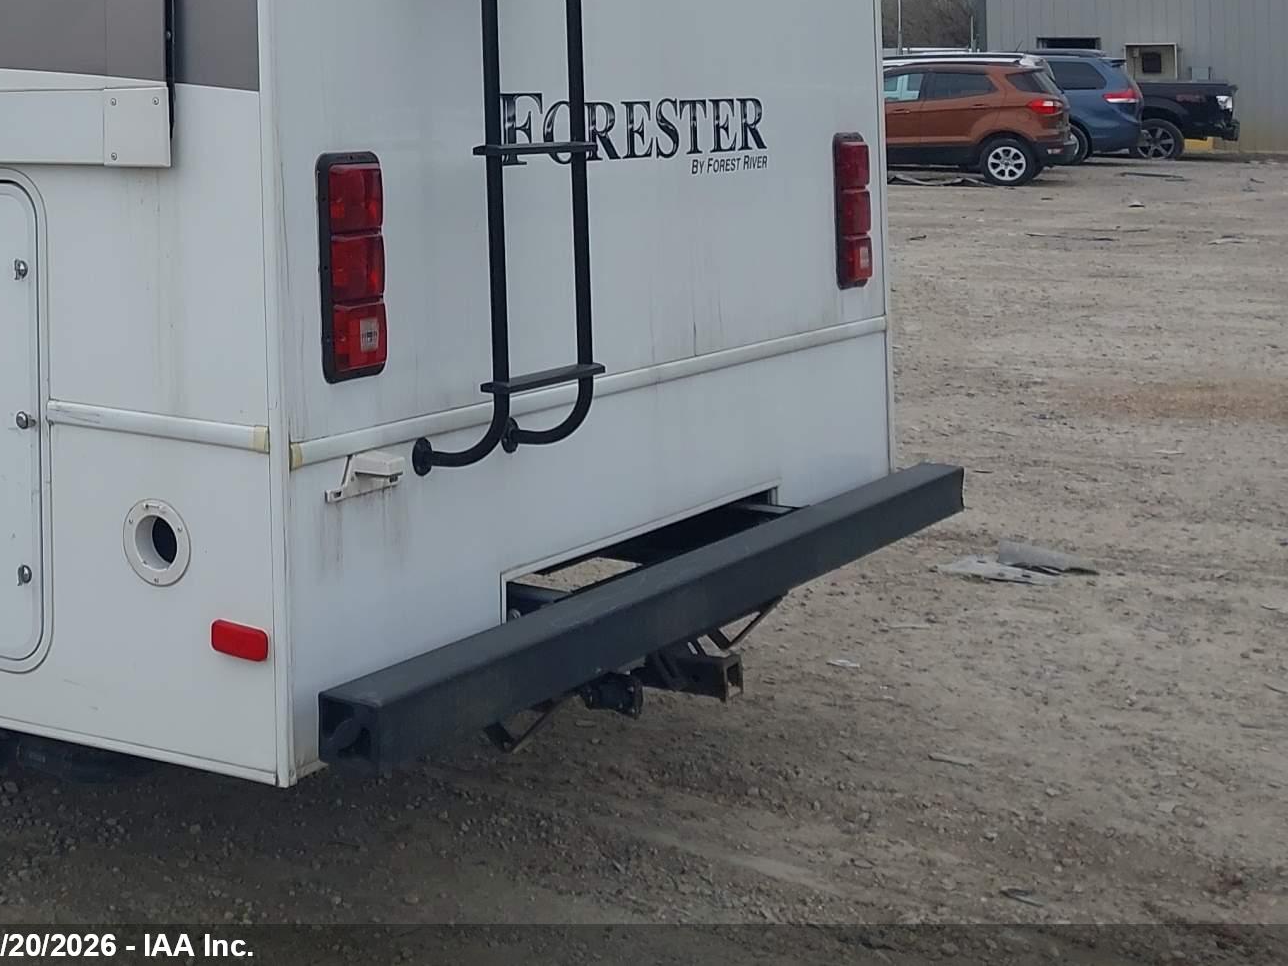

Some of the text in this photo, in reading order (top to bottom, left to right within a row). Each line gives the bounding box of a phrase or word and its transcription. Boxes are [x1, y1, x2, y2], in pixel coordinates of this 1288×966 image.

[499, 92, 767, 166] FORESTER
[691, 154, 768, 175] BY FOREST RIVER
